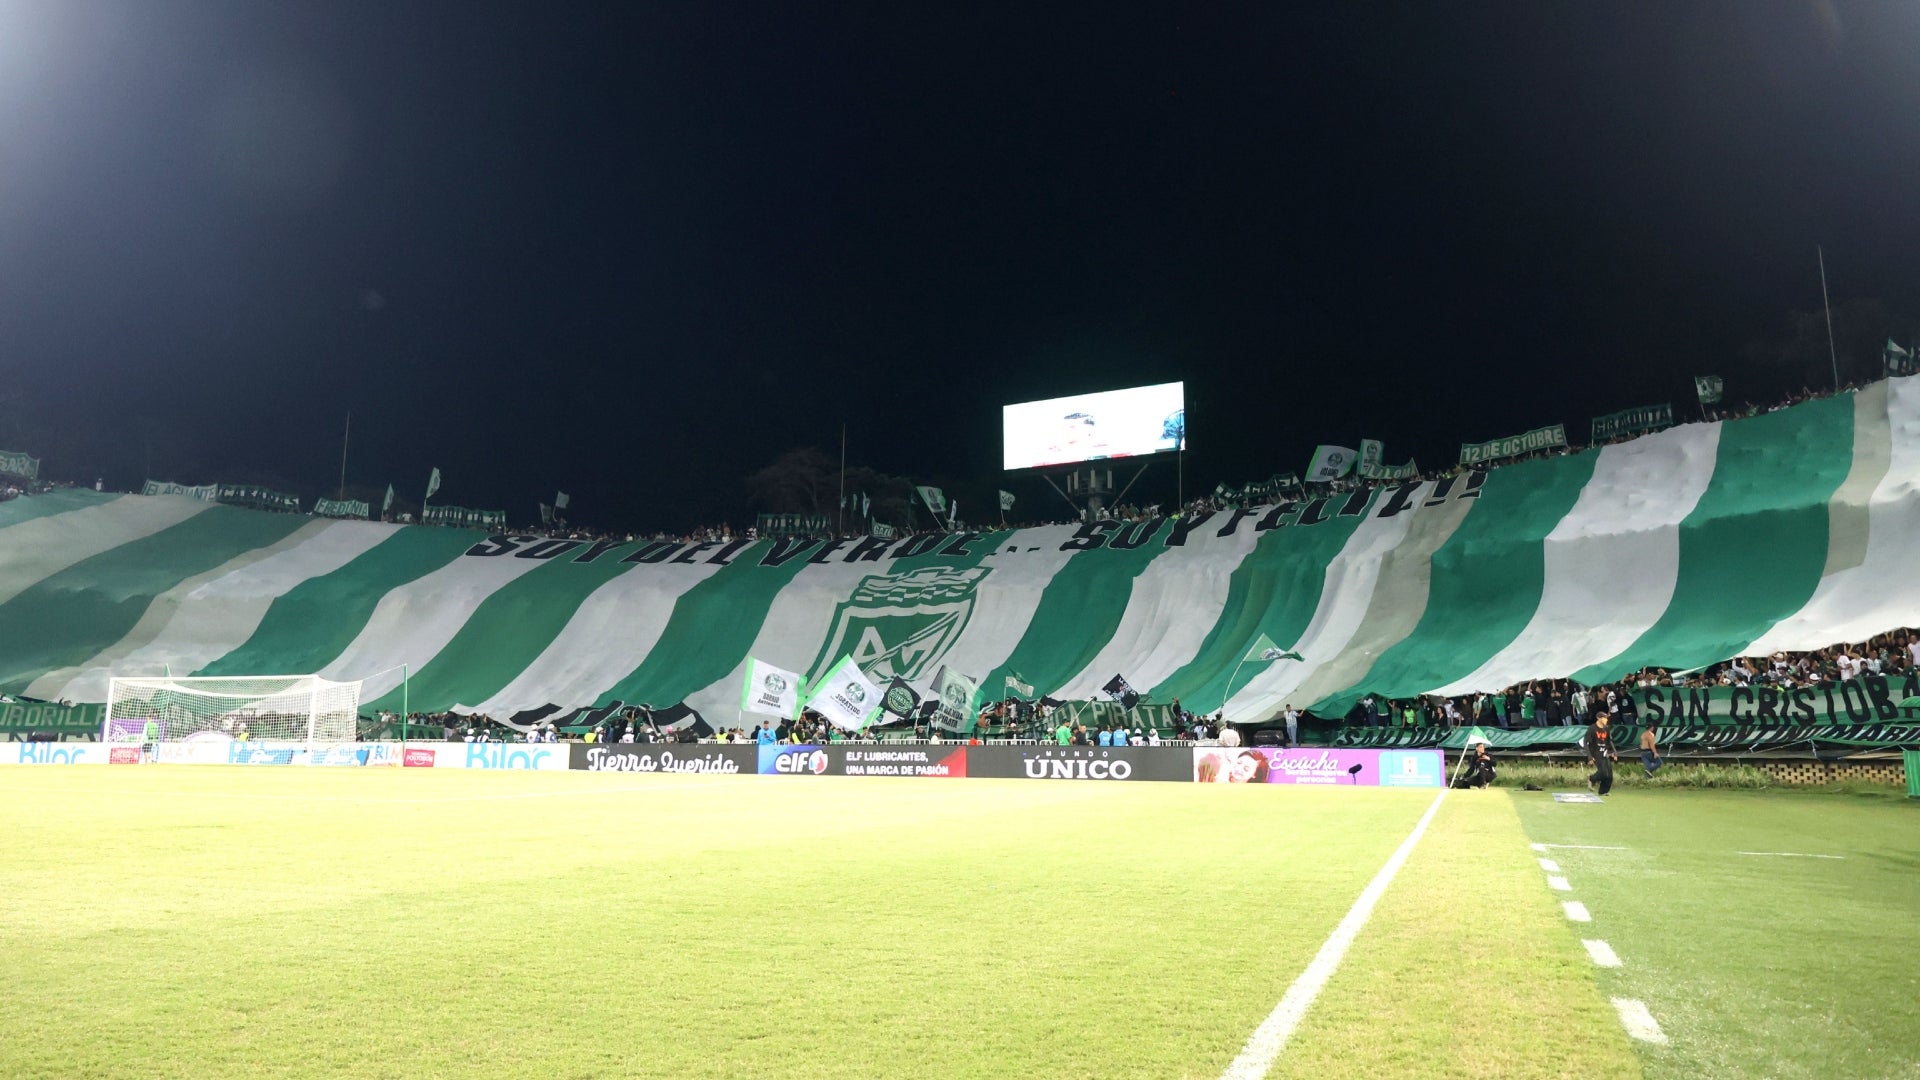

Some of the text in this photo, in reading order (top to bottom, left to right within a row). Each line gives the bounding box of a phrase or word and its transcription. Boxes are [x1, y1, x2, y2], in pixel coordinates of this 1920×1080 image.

[1464, 427, 1564, 462] 12 DE OCTUBRE
[465, 535, 624, 562] SOY
[1059, 510, 1217, 550] SOY
[1646, 687, 1709, 728] SAN
[586, 748, 739, 774] Tierra Querida
[775, 754, 808, 772] elf
[846, 752, 928, 762] ELF LUBRICANTES,
[846, 764, 948, 775] UNA MARCA DE PASIÓN
[1024, 755, 1131, 779] ÚNICO
